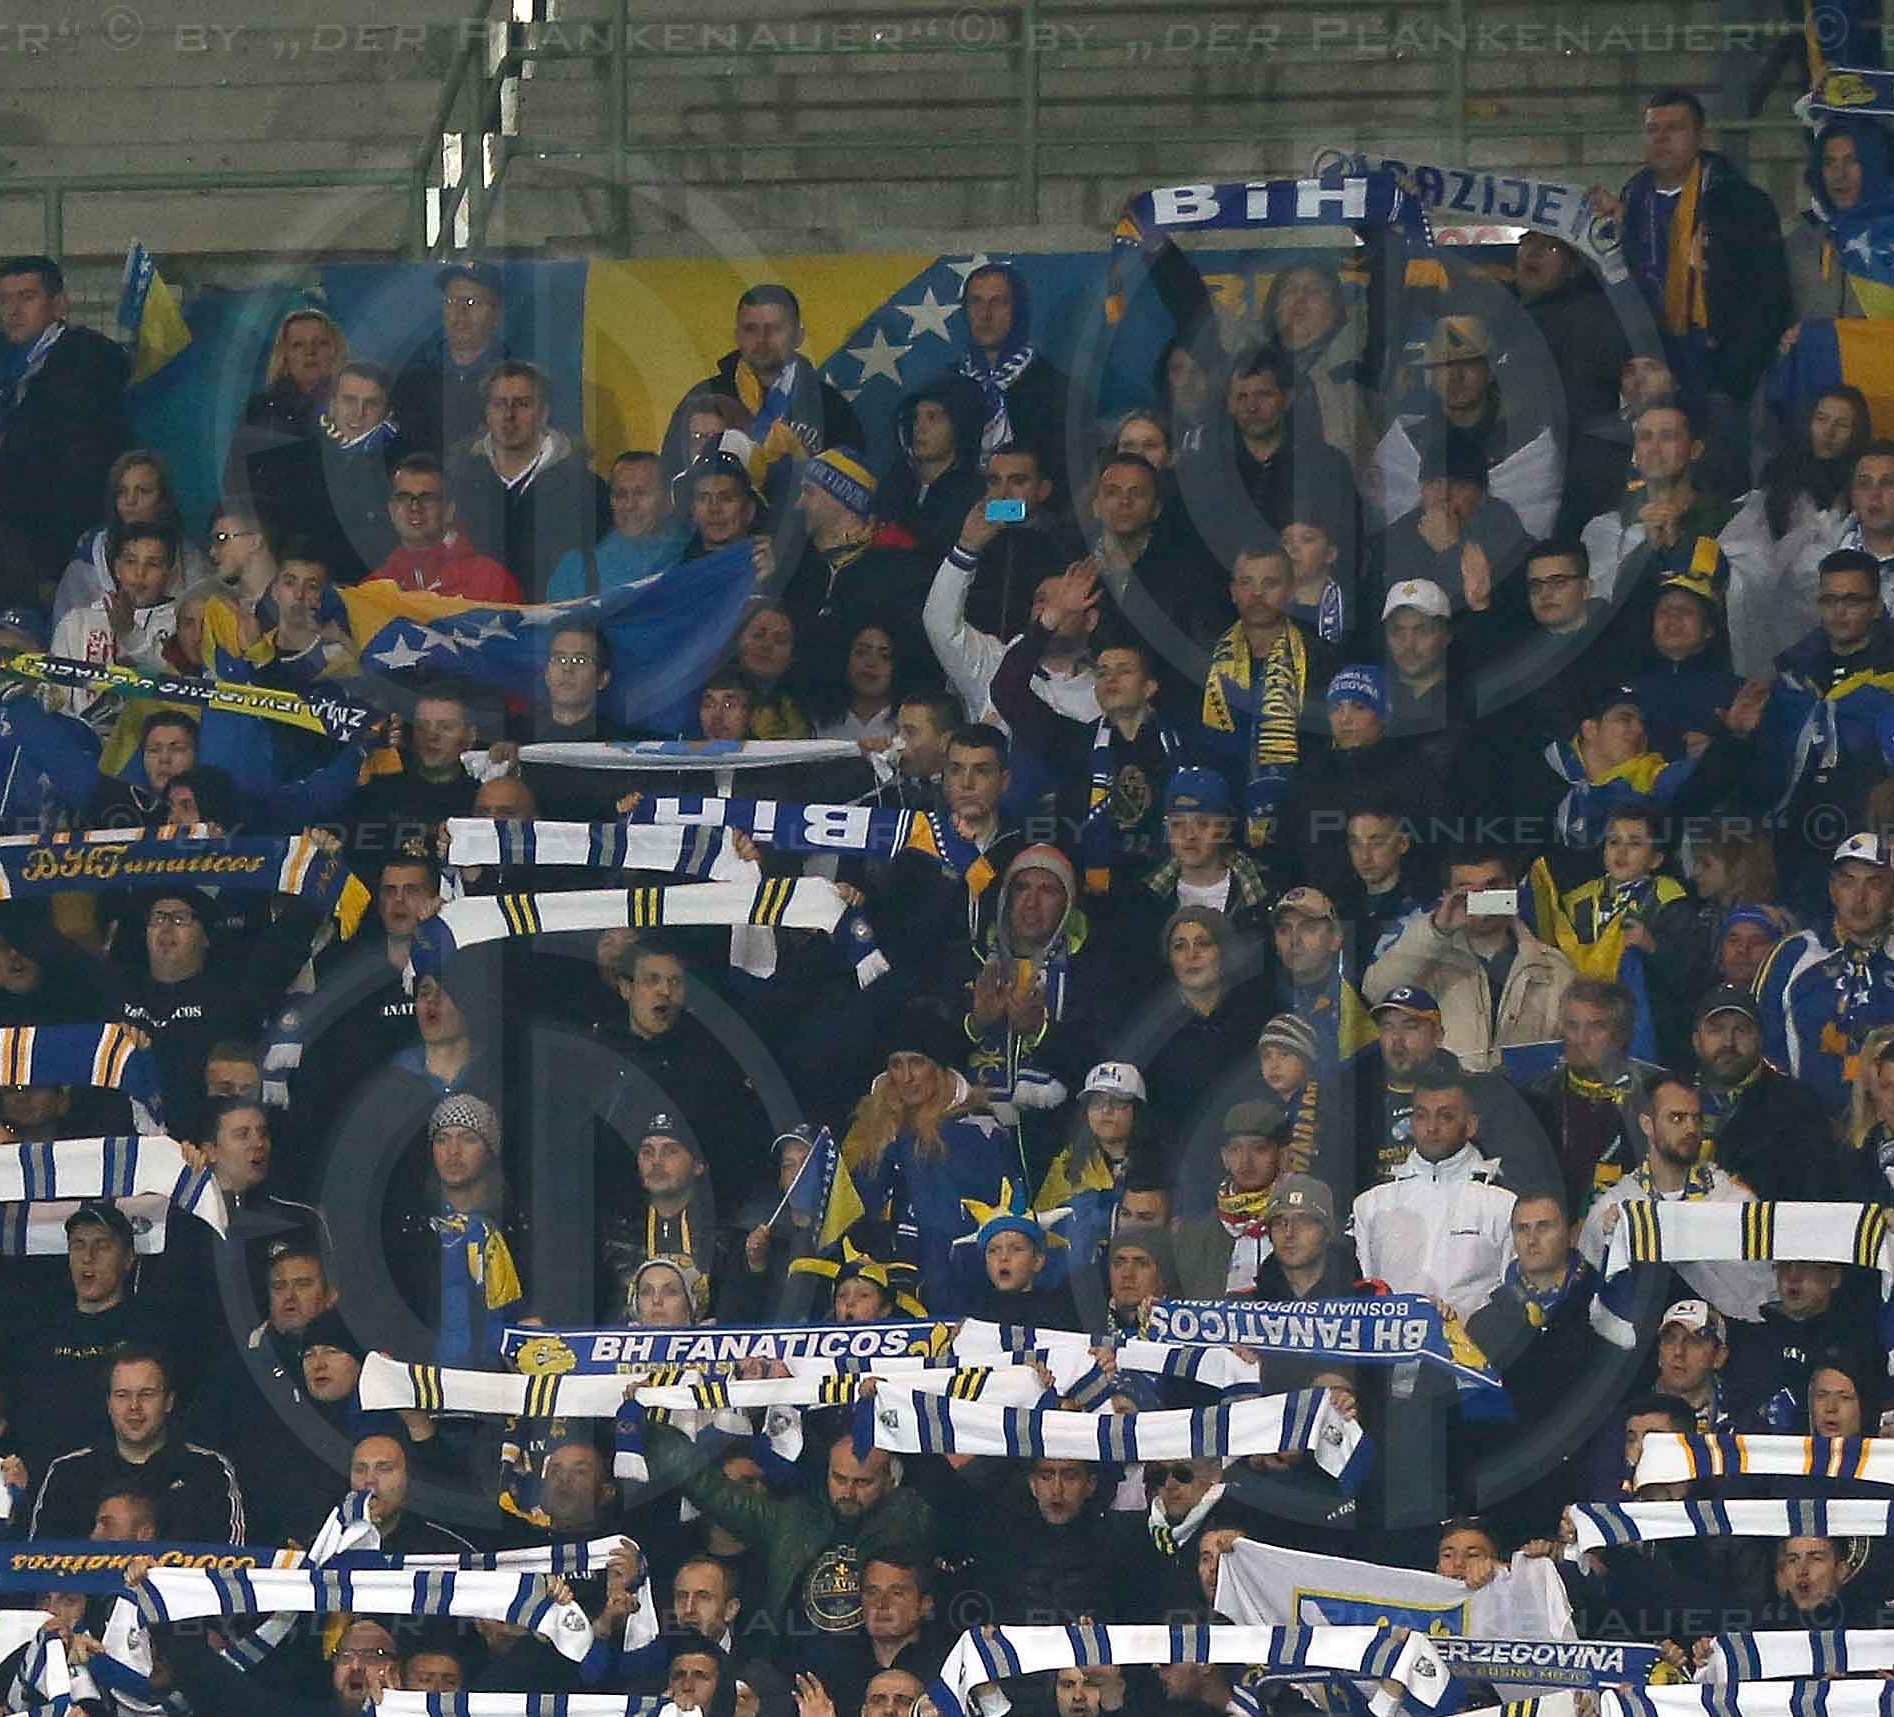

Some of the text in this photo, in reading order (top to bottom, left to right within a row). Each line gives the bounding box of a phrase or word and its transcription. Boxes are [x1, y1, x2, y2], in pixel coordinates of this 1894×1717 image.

[1151, 177, 1368, 224] BiH
[591, 1330, 910, 1361] BH FANATICOS
[1149, 1305, 1429, 1350] BH FANATICOS
[1436, 1640, 1626, 1674] ERZEGOVINA
